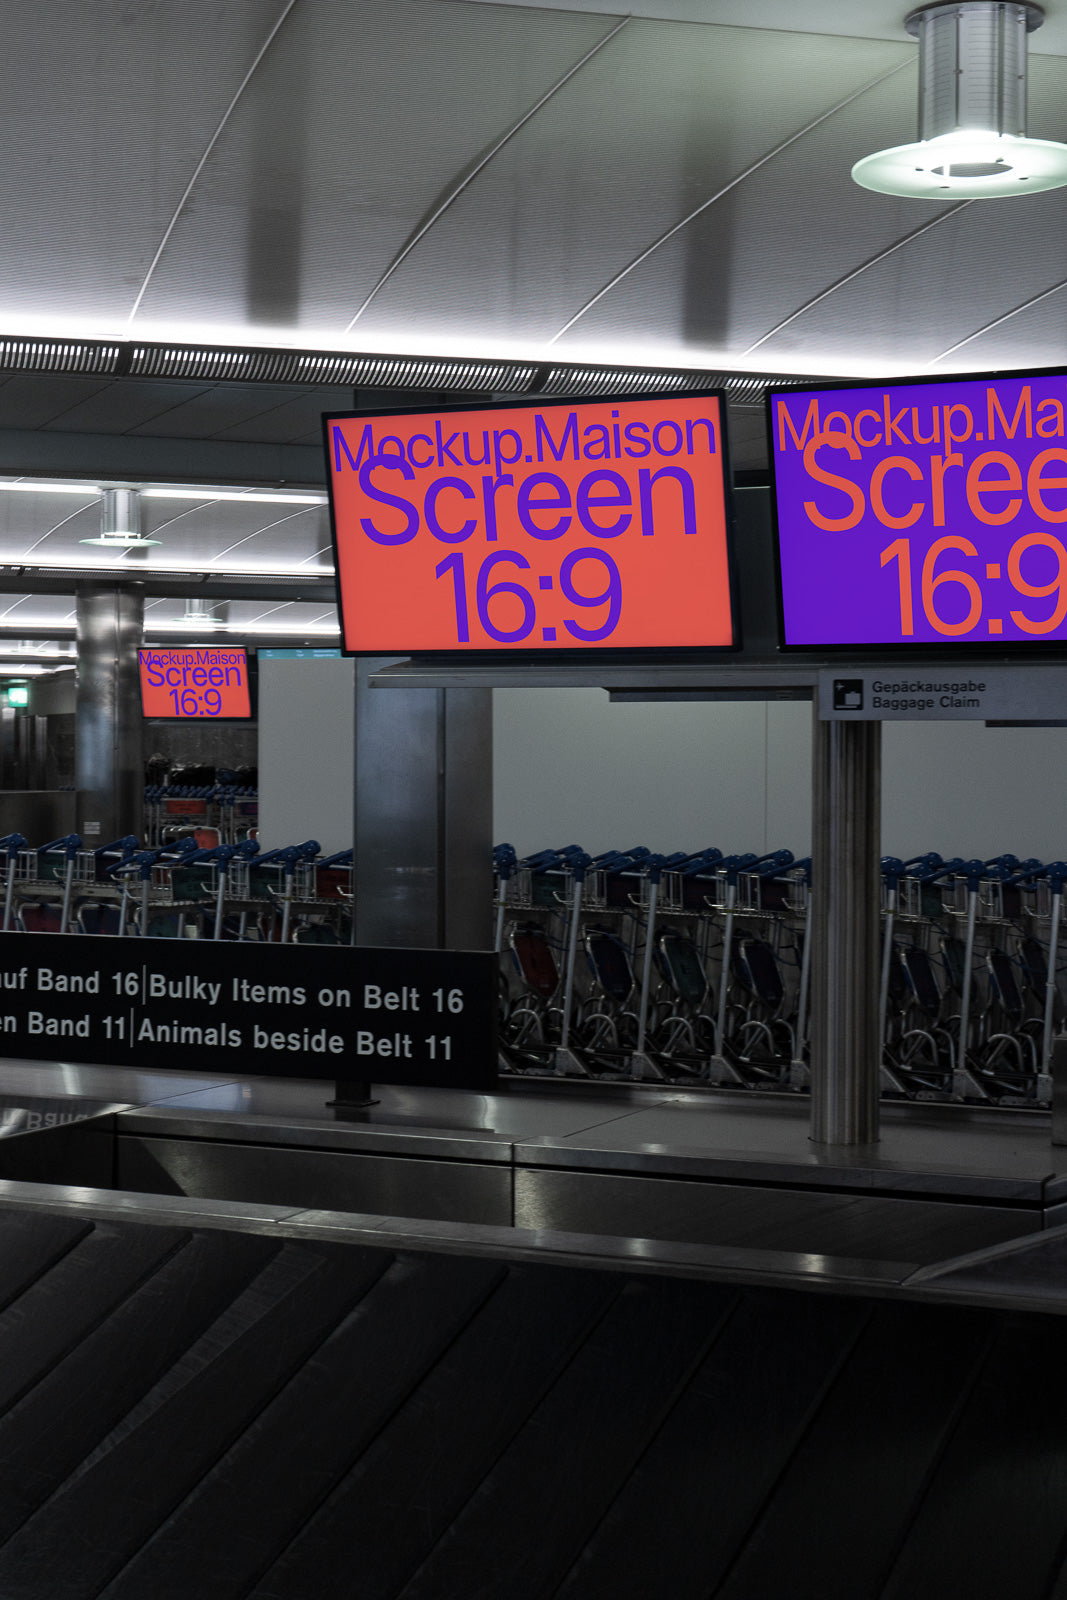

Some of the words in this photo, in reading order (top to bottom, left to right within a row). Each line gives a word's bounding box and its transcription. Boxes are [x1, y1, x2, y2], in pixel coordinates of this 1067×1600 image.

[332, 410, 717, 478] Mockup.Maison
[776, 386, 1065, 456] Mockup.Ma
[358, 453, 697, 546] Screen
[802, 431, 1067, 532] Scree
[435, 547, 623, 643] 16:9
[880, 532, 1067, 637] 16:9
[139, 650, 246, 669] Mockup.Maison
[146, 660, 241, 687] Screen
[169, 688, 222, 716] 16:9
[872, 680, 986, 694] Gepäckausgabe
[872, 697, 934, 710] Baggage
[939, 696, 980, 708] Claim
[0, 967, 28, 990] uf
[37, 968, 100, 994] Band
[112, 972, 139, 997] 16
[150, 974, 221, 1006] Bulky
[232, 977, 306, 1005] Items
[318, 989, 351, 1008] on
[364, 985, 420, 1012] Belt
[432, 988, 464, 1014] 16
[28, 1011, 90, 1038] Band
[102, 1016, 125, 1040] 11
[137, 1018, 242, 1048] Animals
[253, 1024, 344, 1054] beside
[357, 1031, 413, 1059] Belt
[425, 1035, 451, 1061] 11
